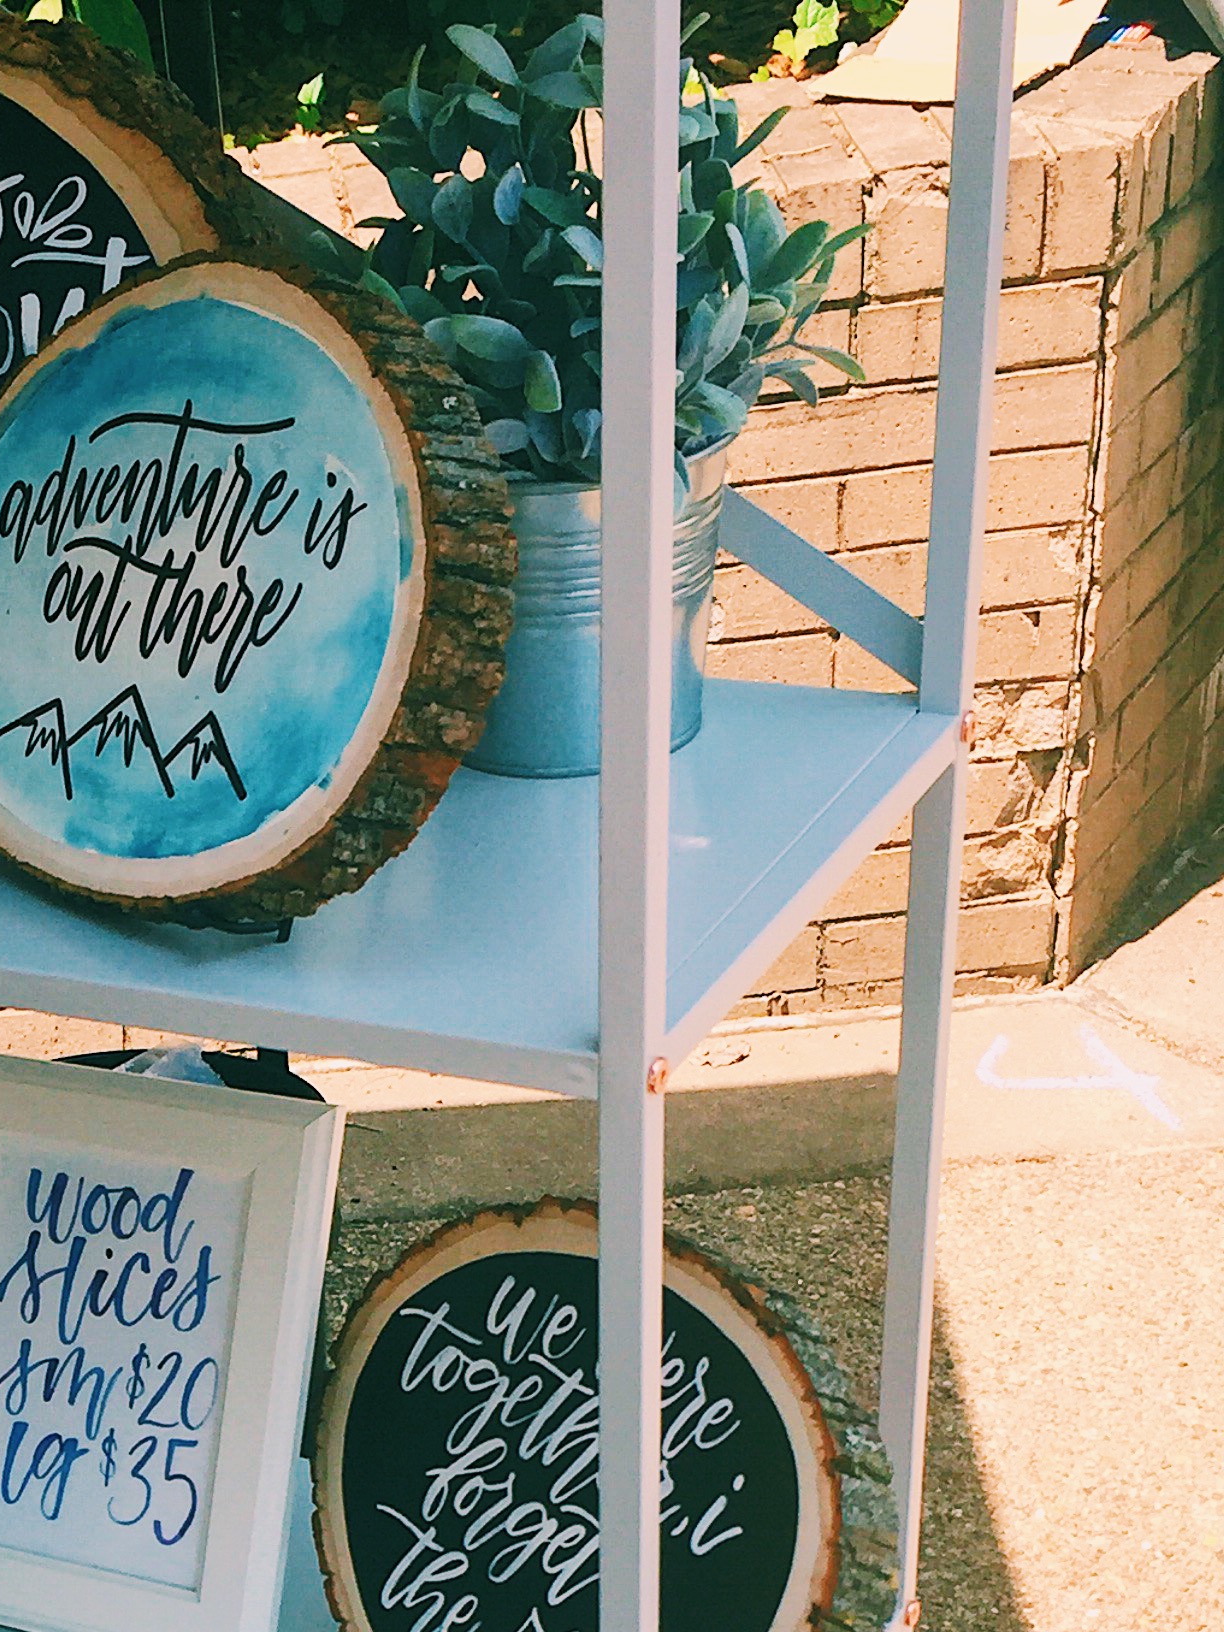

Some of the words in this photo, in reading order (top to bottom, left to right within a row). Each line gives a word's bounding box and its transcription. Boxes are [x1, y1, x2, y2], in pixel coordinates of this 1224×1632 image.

[304, 476, 367, 569] is
[43, 534, 132, 662] out
[140, 549, 302, 692] there
[26, 1167, 195, 1264] wood
[126, 1342, 219, 1431] $20
[0, 1420, 90, 1520] lg
[99, 1428, 198, 1545] $35
